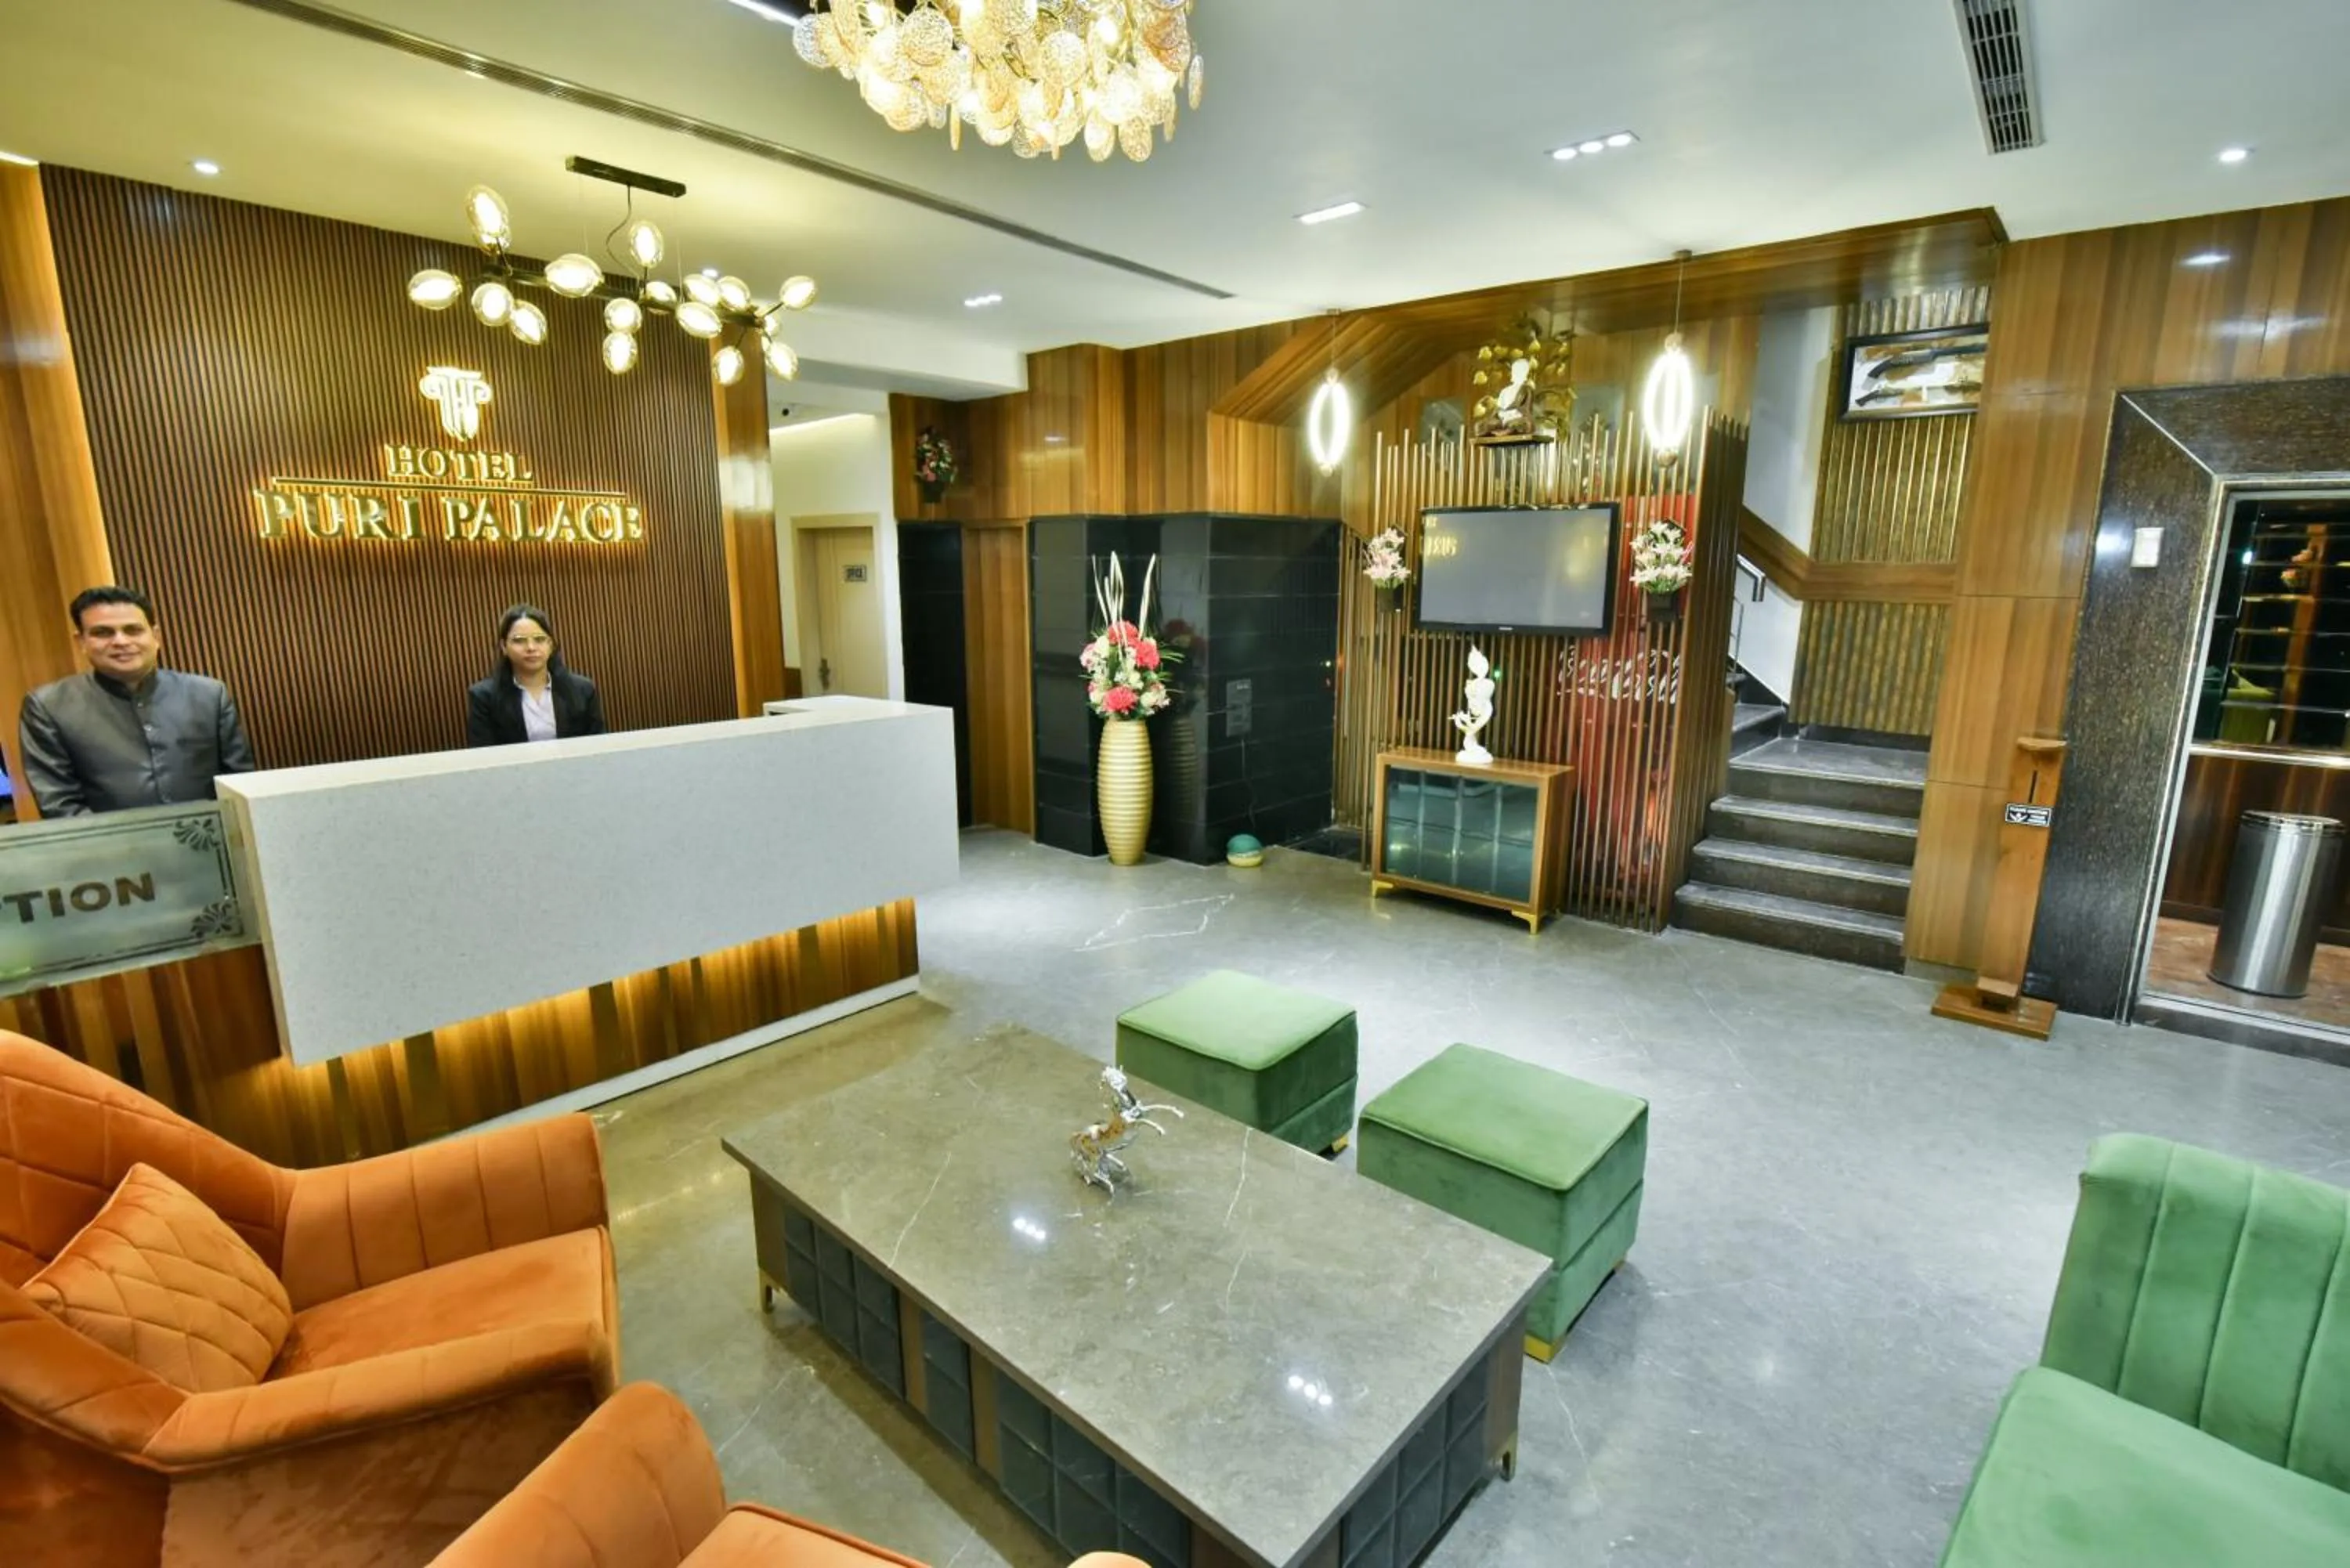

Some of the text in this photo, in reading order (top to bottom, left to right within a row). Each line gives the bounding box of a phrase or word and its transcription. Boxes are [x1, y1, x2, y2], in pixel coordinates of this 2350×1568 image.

[384, 443, 533, 482] HOTEL
[253, 489, 643, 544] PURI PALACE
[0, 871, 156, 924] TION
